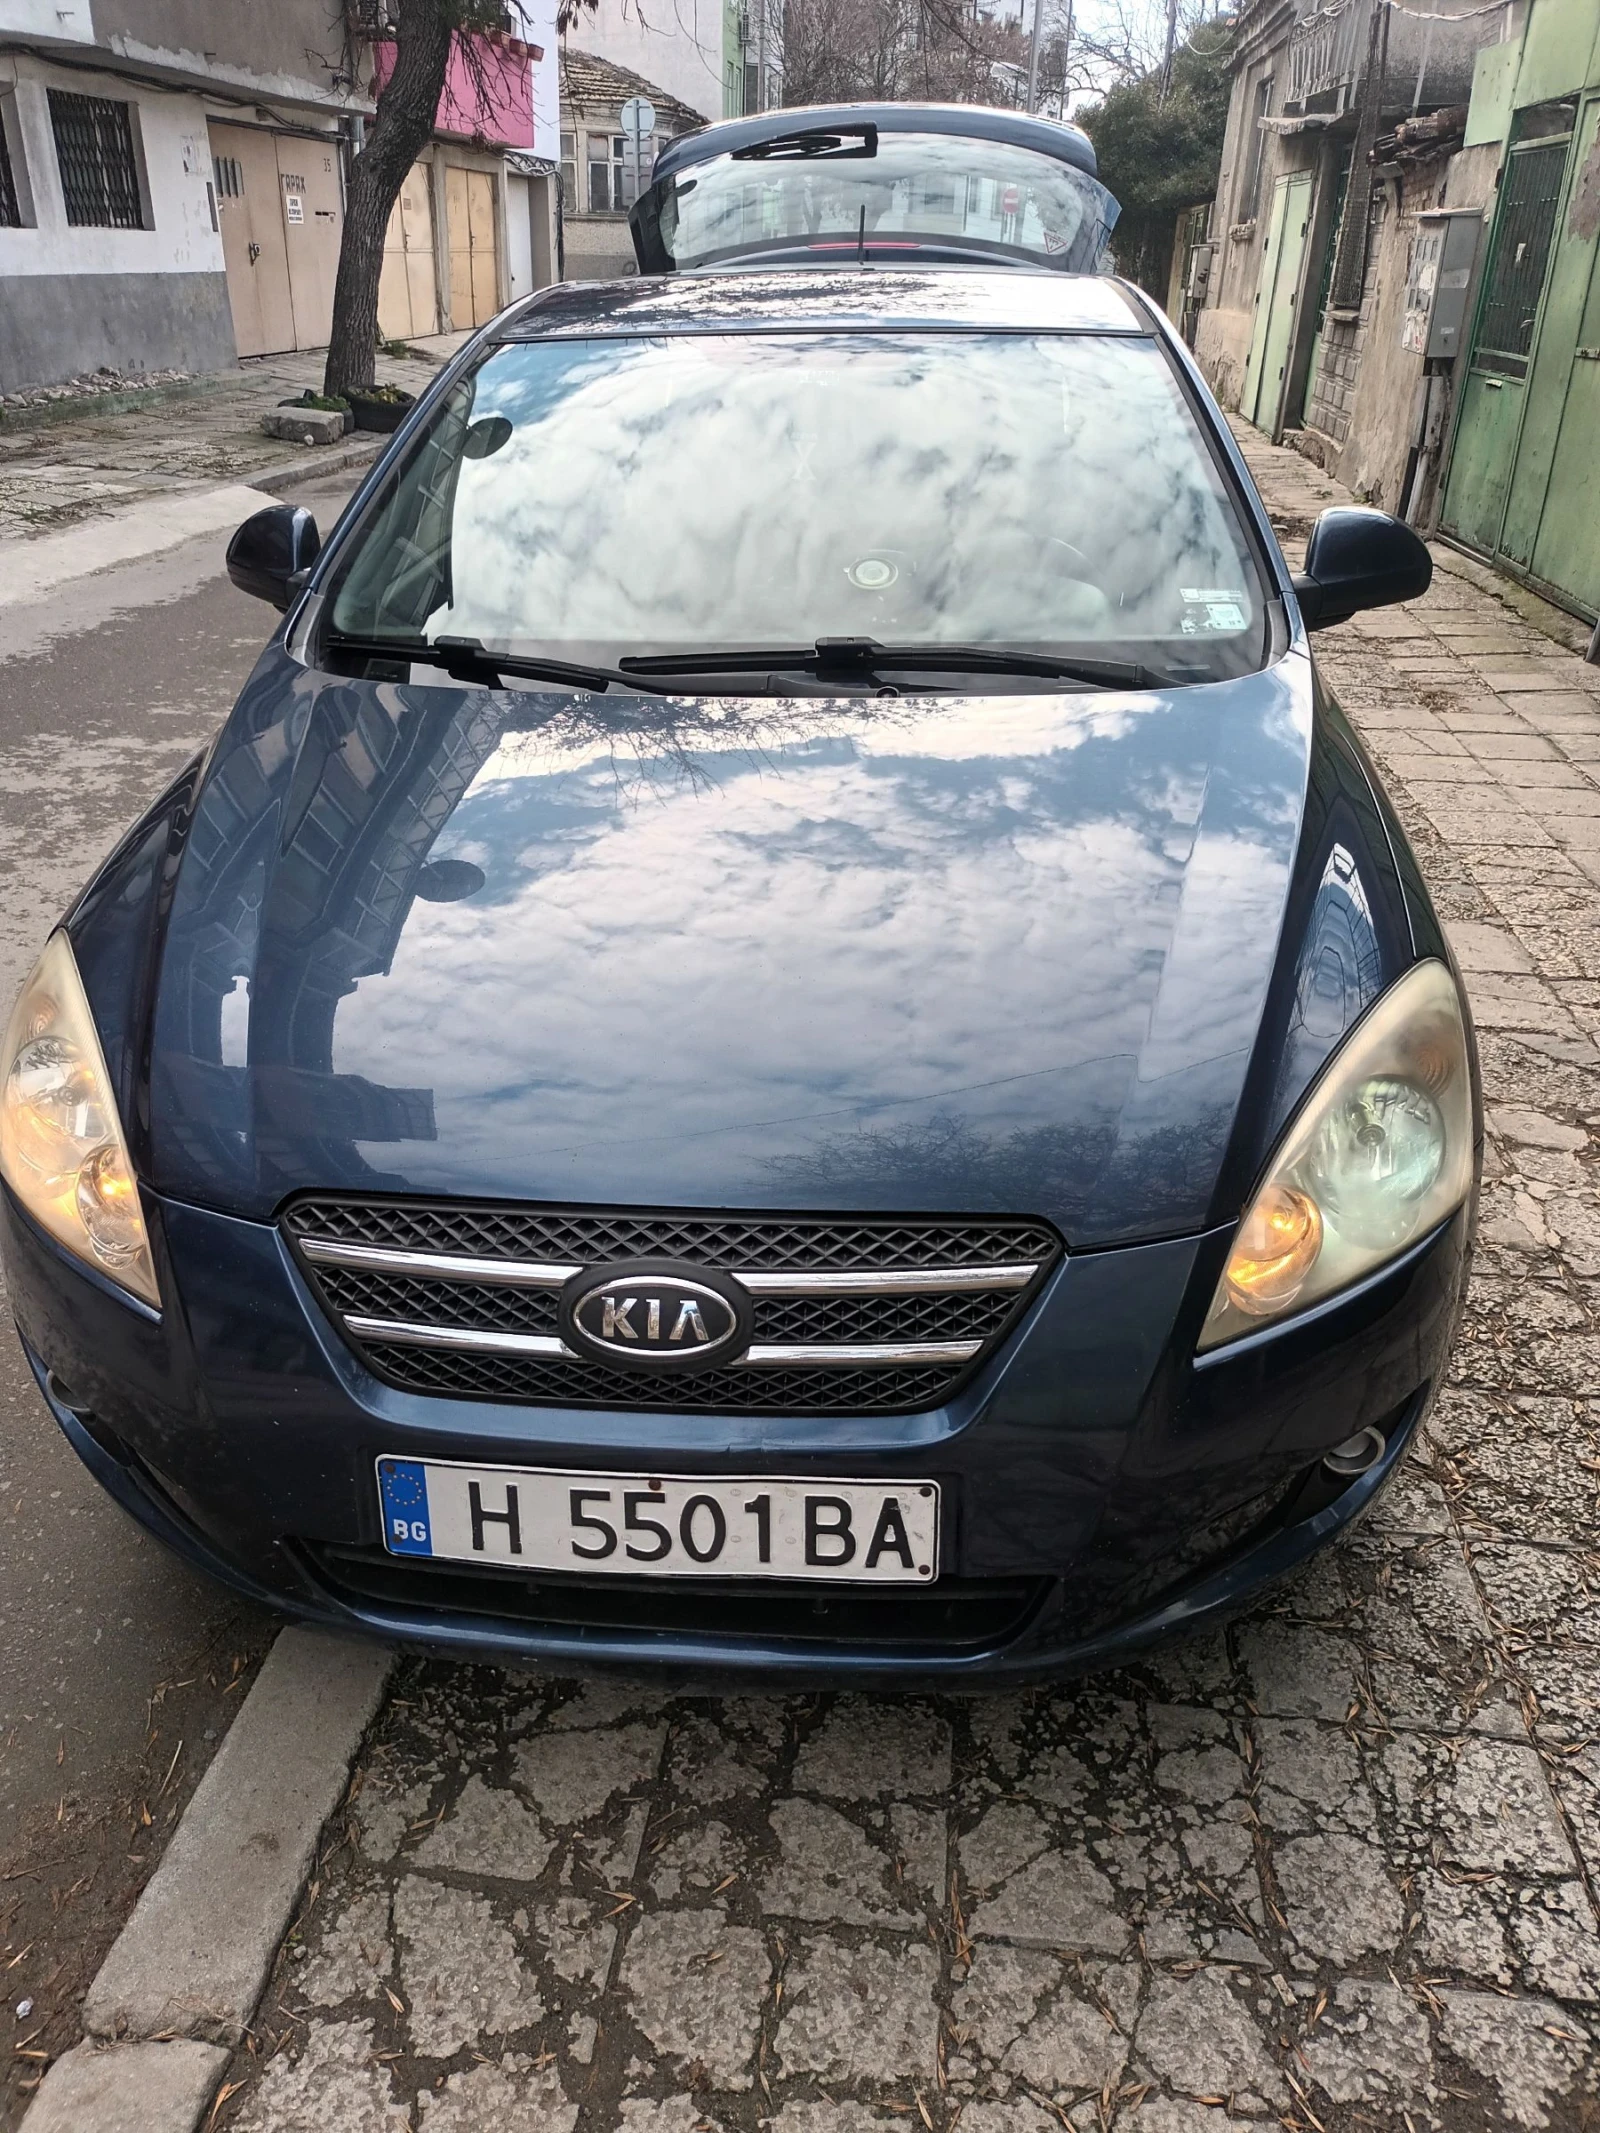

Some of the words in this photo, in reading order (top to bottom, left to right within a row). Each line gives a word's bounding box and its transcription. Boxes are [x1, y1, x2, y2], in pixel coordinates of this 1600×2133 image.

[601, 1296, 710, 1341] KIA
[393, 1518, 427, 1542] BG
[569, 1488, 771, 1564] 5501
